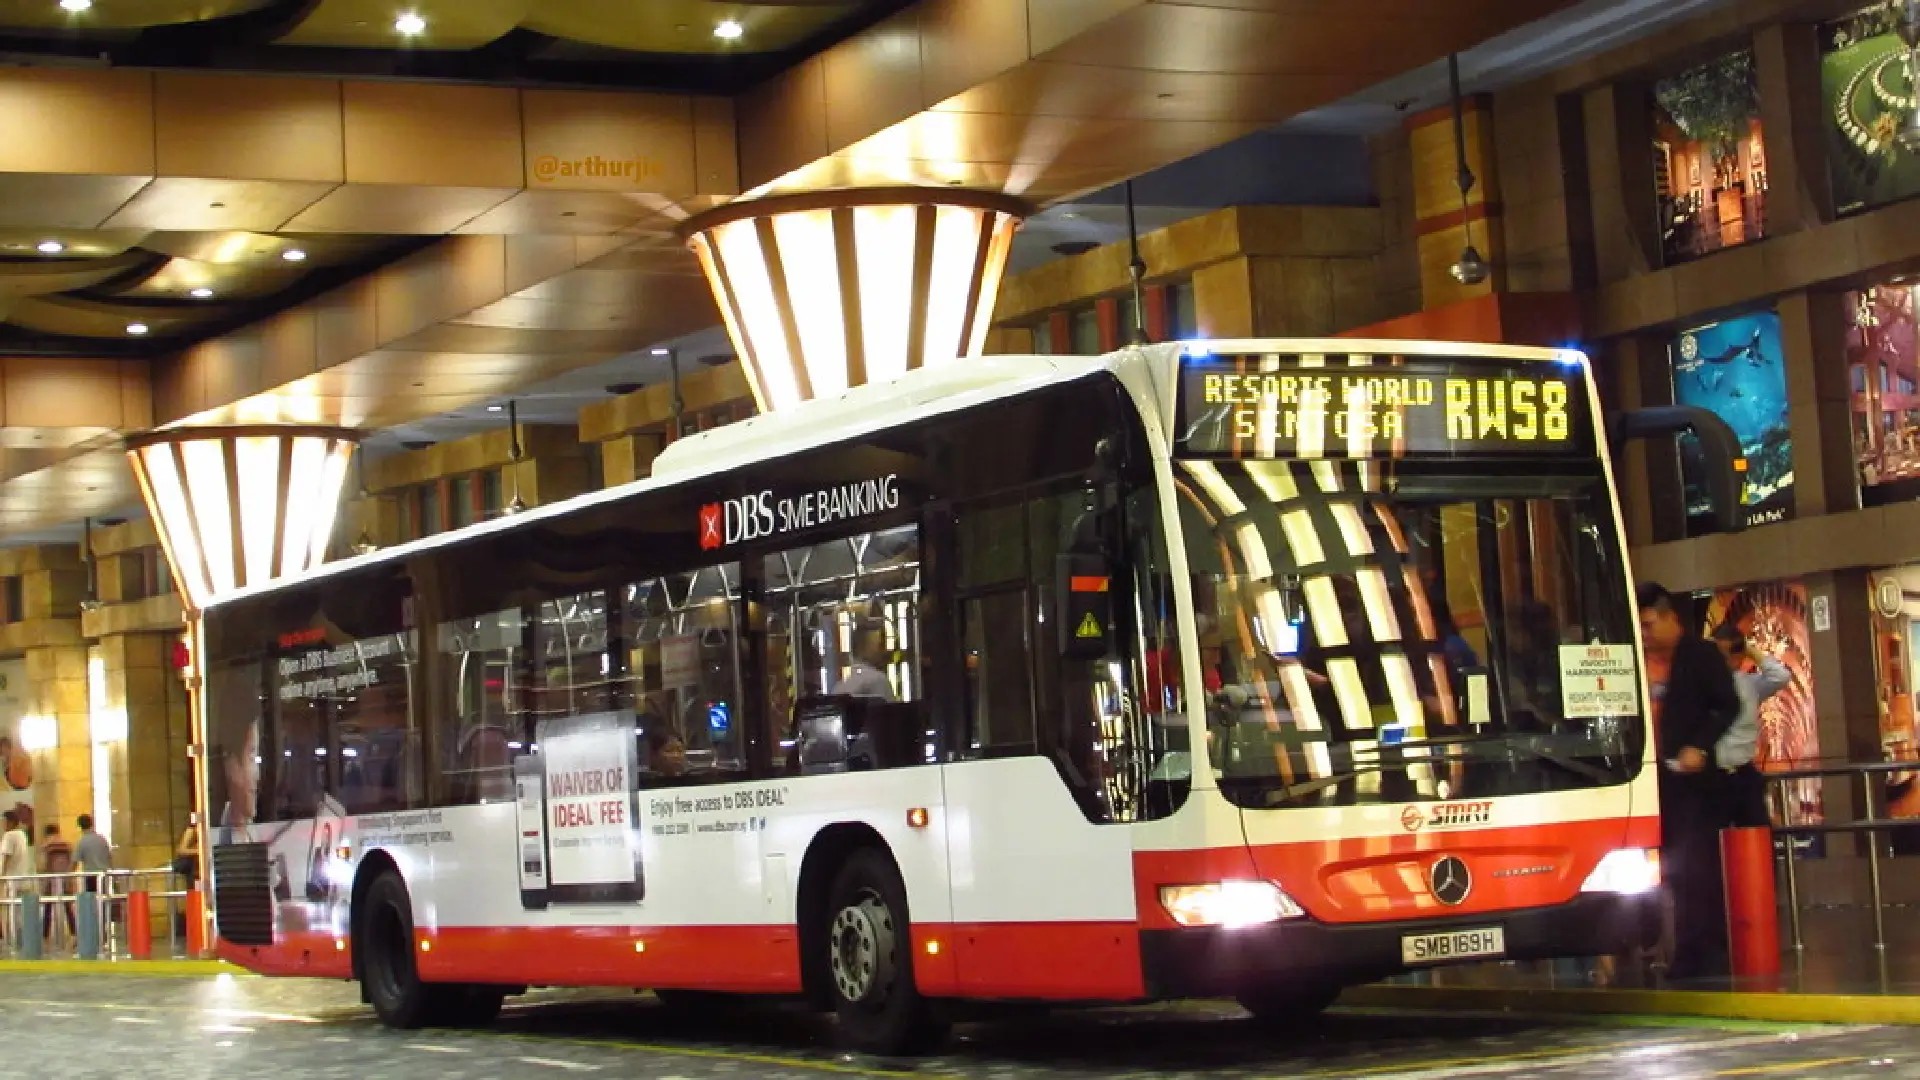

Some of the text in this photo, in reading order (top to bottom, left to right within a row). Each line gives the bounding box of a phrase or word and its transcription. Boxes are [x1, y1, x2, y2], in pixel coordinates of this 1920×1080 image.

[1205, 374, 1433, 406] RESORTS WORLD
[1446, 378, 1568, 441] RWS8
[1234, 410, 1404, 439] SNOSA
[723, 473, 899, 545] DBS SME BANKING
[550, 767, 623, 798] WAIVER OF
[553, 800, 625, 828] IDEAL FEE
[651, 798, 674, 818] Enjoy
[675, 794, 693, 812] free
[695, 797, 722, 812] access
[723, 794, 733, 810] to
[735, 790, 754, 808] DBS
[1428, 801, 1494, 826] SMRT
[1413, 931, 1495, 958] SMB169H
